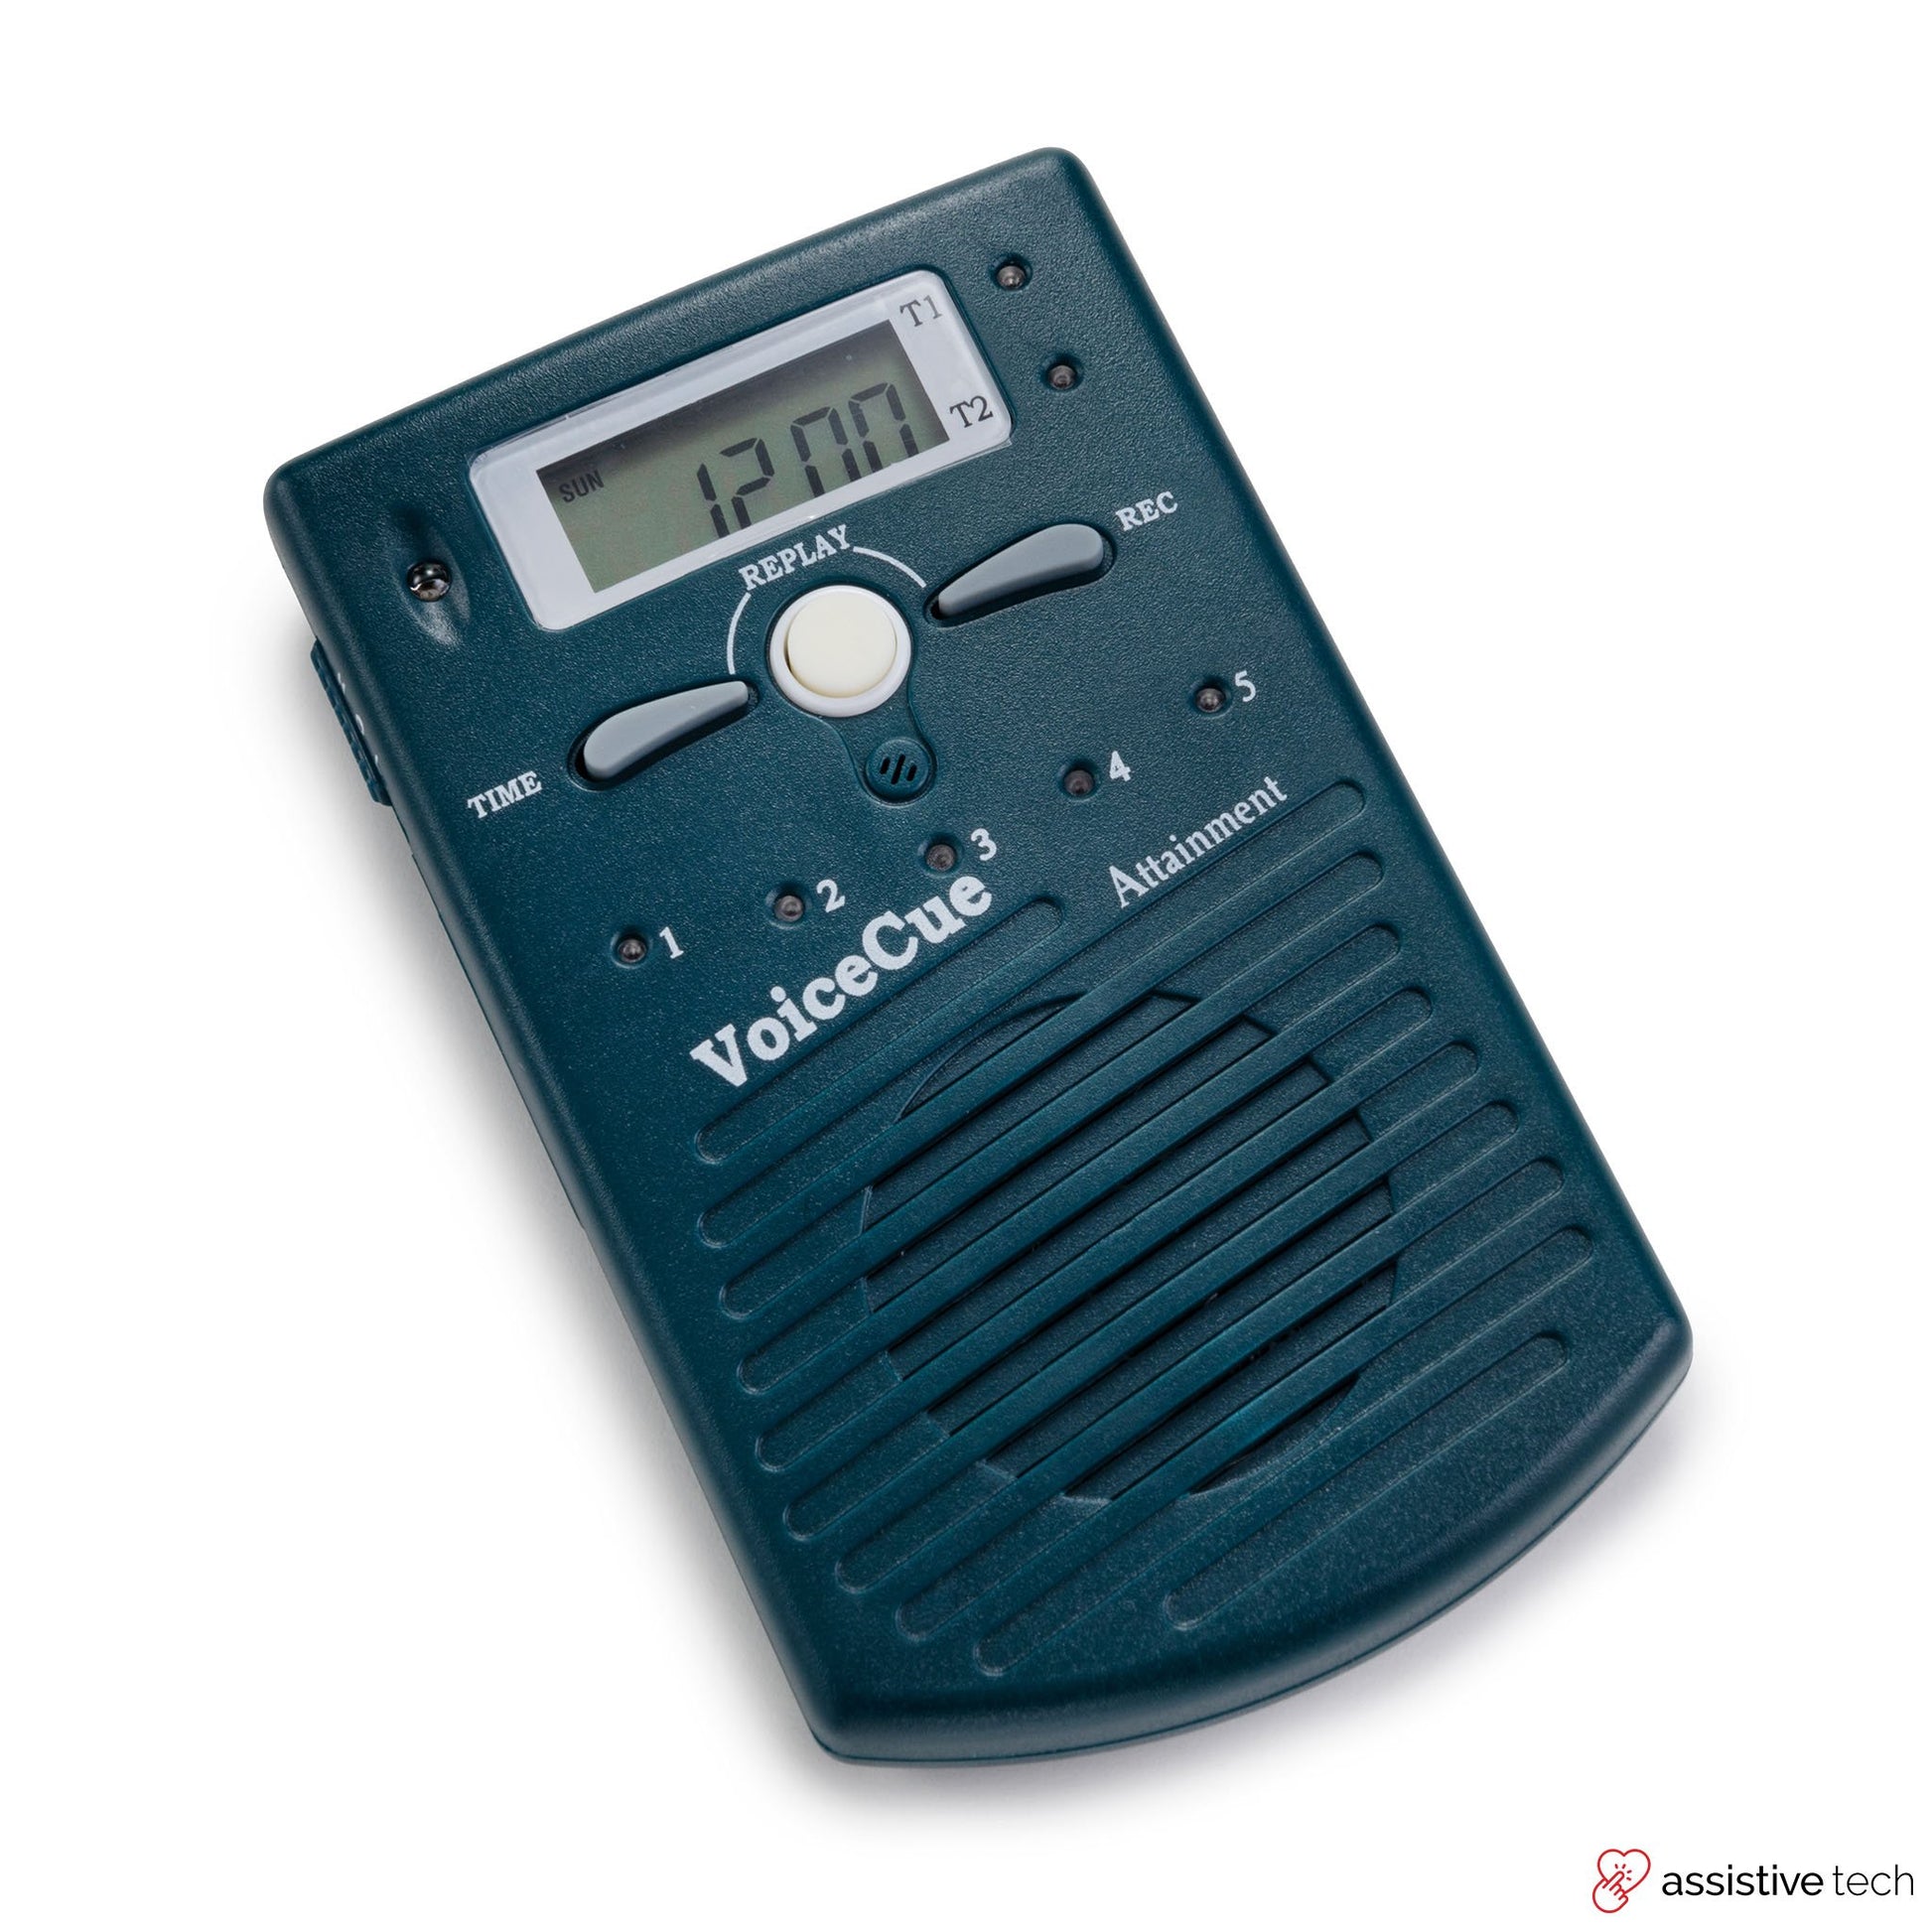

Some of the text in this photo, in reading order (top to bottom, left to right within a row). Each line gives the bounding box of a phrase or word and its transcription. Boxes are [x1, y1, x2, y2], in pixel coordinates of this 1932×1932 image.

[900, 295, 943, 328] T1
[949, 394, 994, 429] T2
[558, 469, 606, 504] SUN
[1115, 490, 1178, 532] REC
[738, 523, 852, 591] REPLAY
[1233, 669, 1257, 702] 5
[1108, 750, 1132, 782] 4
[467, 769, 543, 820] TIME
[969, 827, 997, 862] 3
[1107, 774, 1289, 909] Attainment
[815, 878, 846, 913] 2
[658, 925, 685, 960] 1
[689, 875, 993, 1088] VoiceCue
